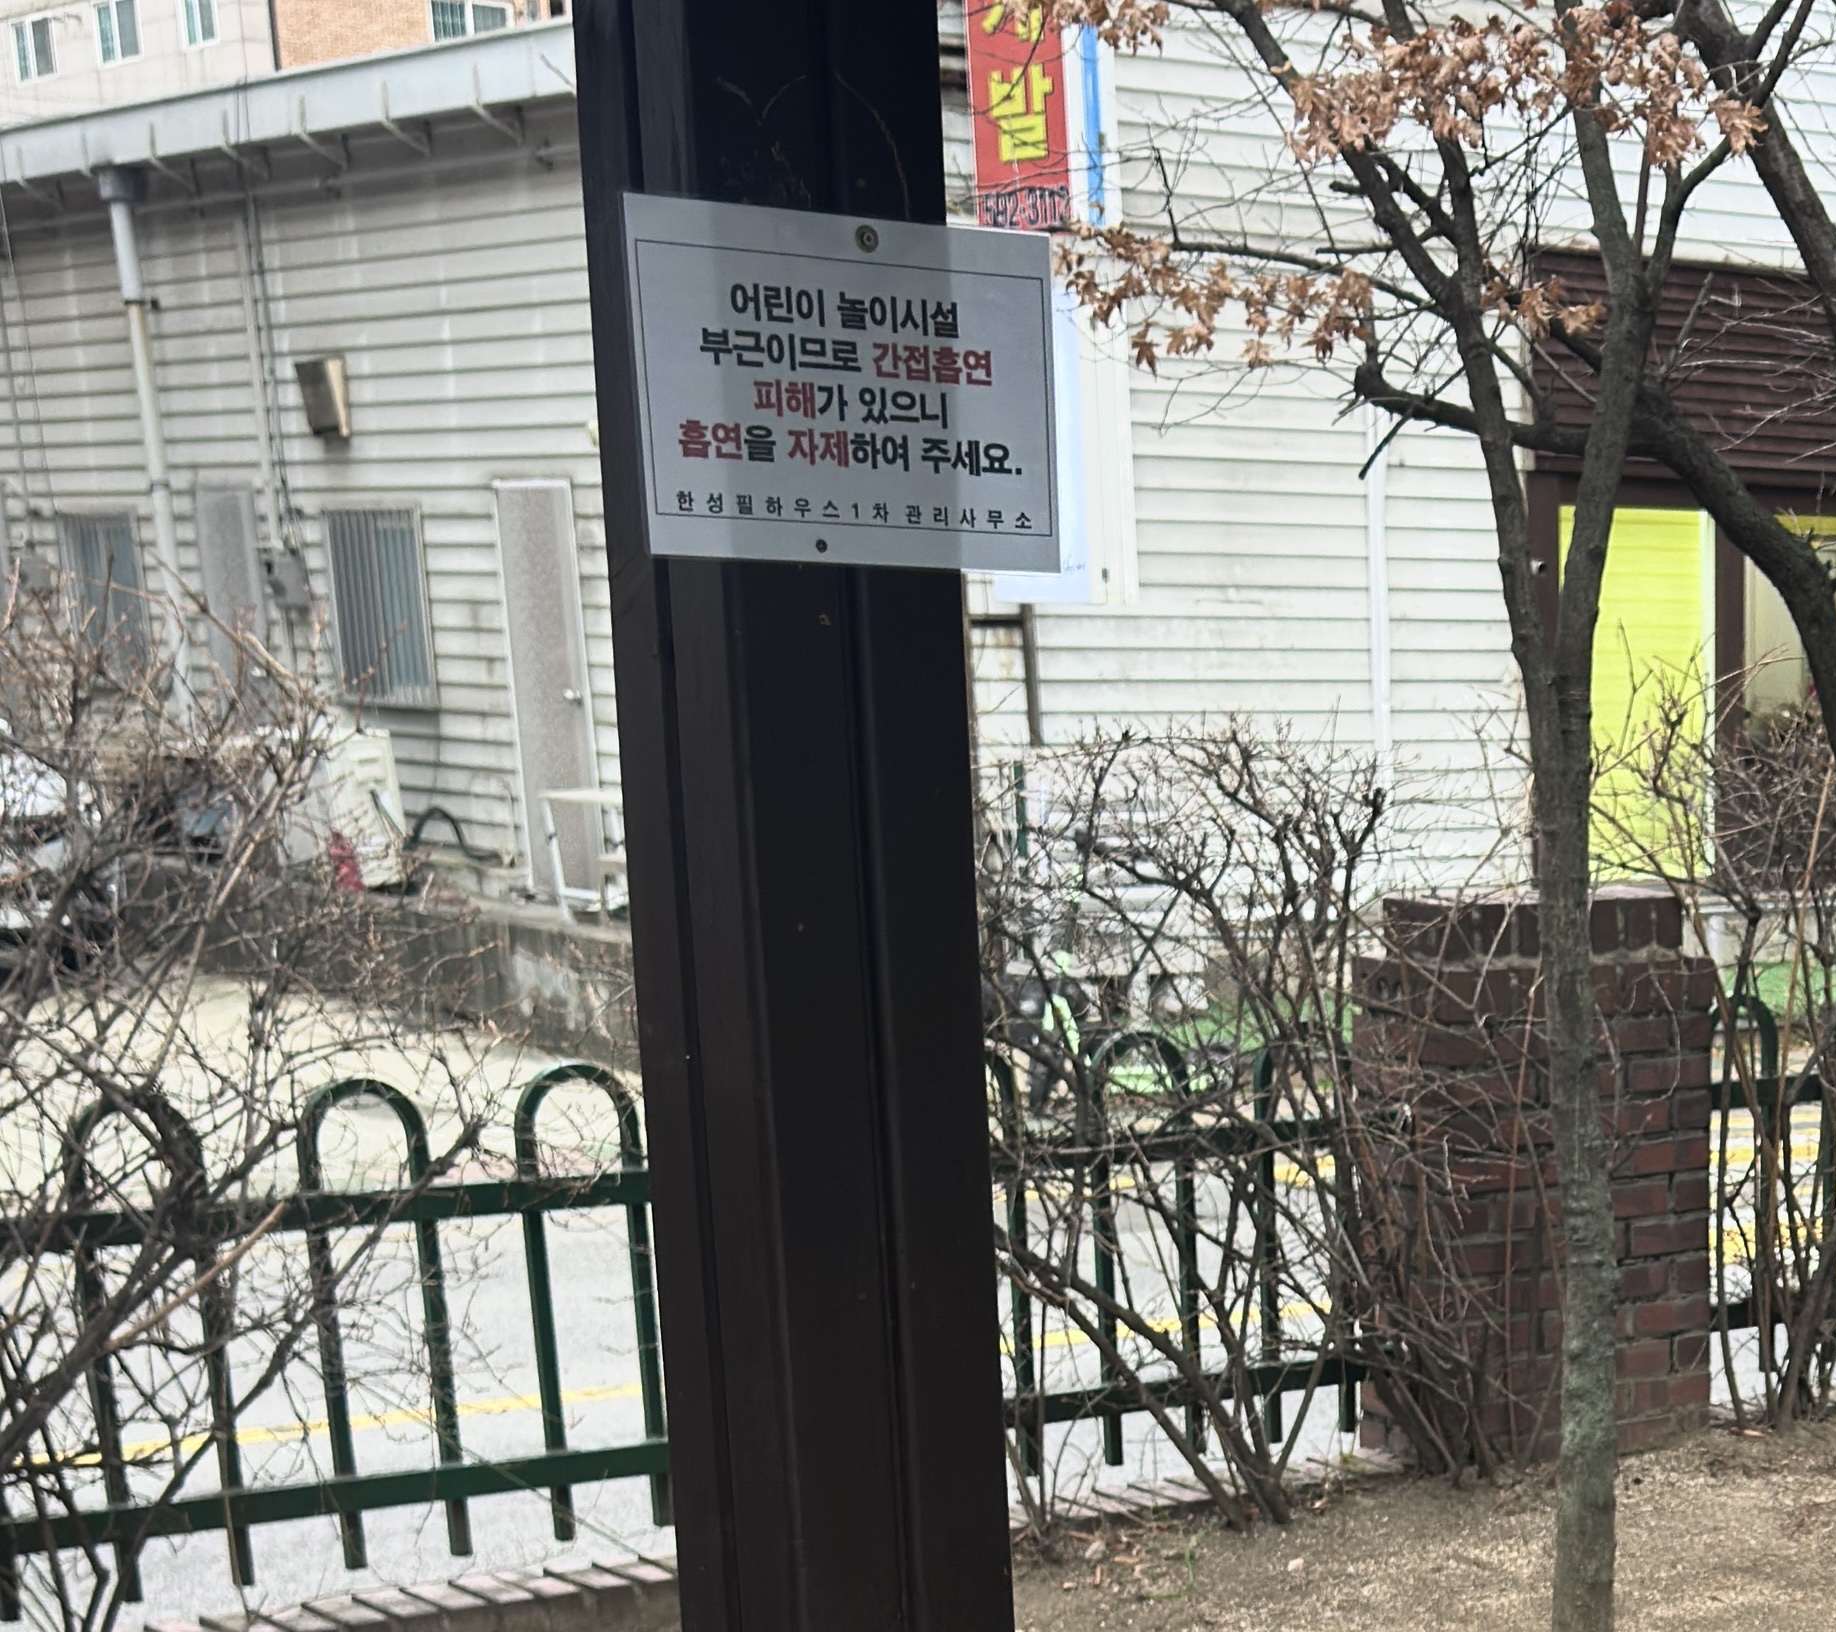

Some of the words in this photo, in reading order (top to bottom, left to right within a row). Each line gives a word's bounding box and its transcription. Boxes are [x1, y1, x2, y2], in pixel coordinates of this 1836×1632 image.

[730, 283, 825, 327] 어린이
[837, 291, 960, 339] 놀이시설
[700, 327, 862, 372] 부근이므로
[872, 342, 993, 387] 간접흡연
[753, 379, 849, 422] 피해가
[859, 387, 948, 430] 있으니
[678, 419, 777, 463] 흡연을
[787, 428, 910, 472] 자제하여
[920, 437, 1023, 477] 주세요.
